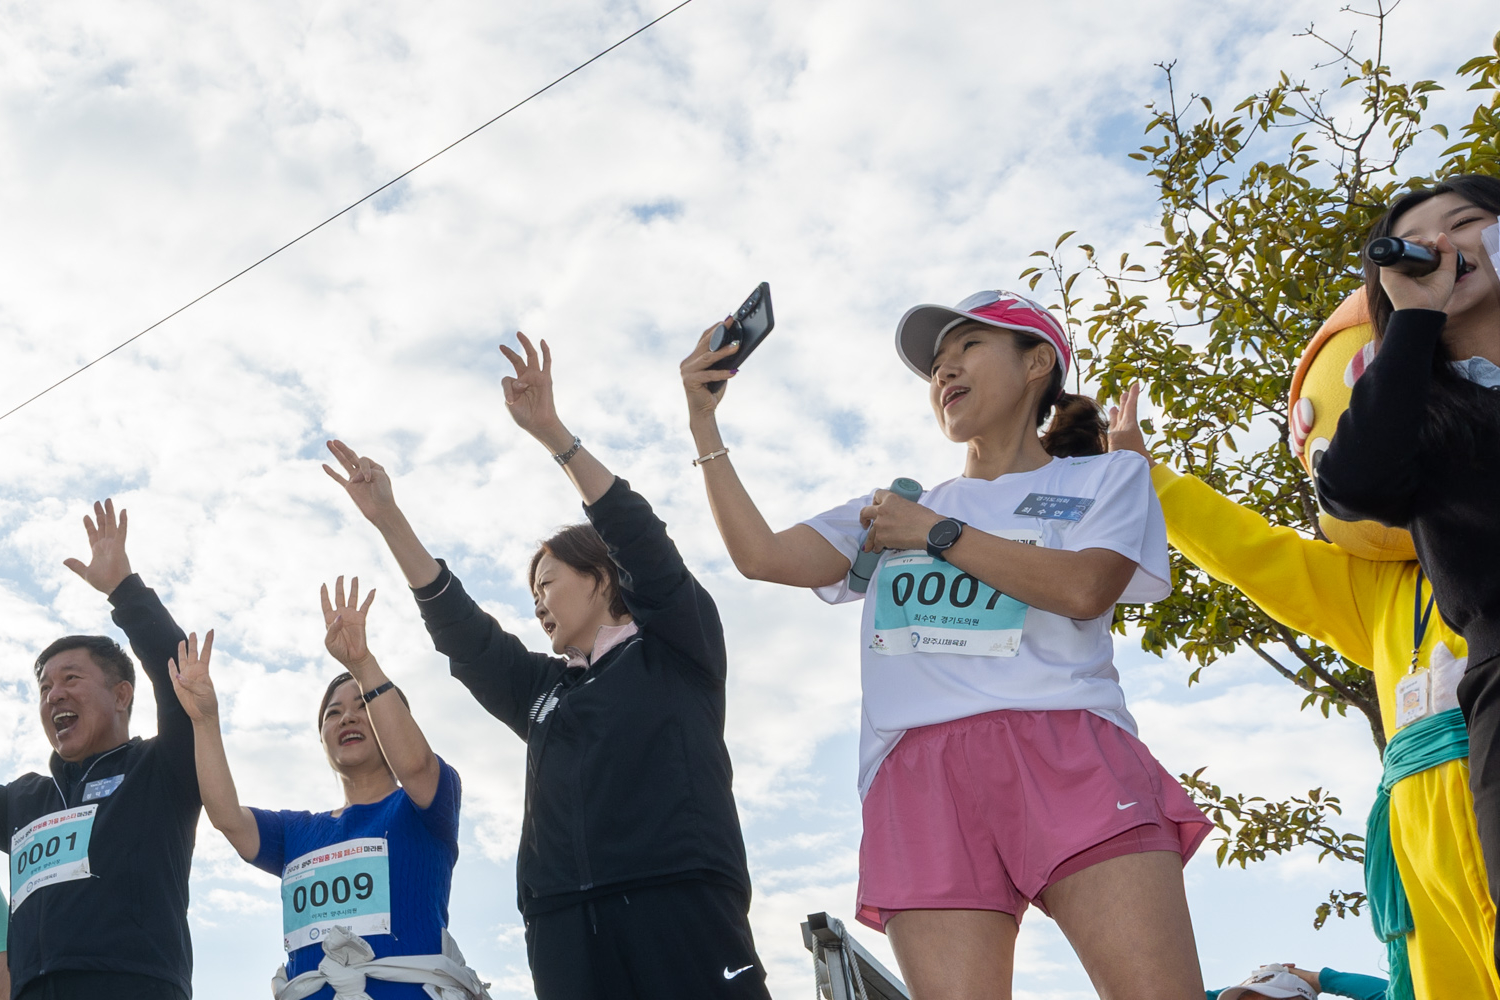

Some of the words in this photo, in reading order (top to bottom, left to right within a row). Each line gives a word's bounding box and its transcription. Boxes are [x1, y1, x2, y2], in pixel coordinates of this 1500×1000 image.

[913, 613, 936, 623] 최수연
[940, 615, 980, 626] 경기도의원
[922, 636, 967, 647] 양주시체육회
[17, 832, 77, 875] 0001
[331, 850, 343, 860] 가을
[343, 846, 363, 857] 페스타
[363, 845, 383, 853] 마라톤
[293, 872, 374, 914] 0009
